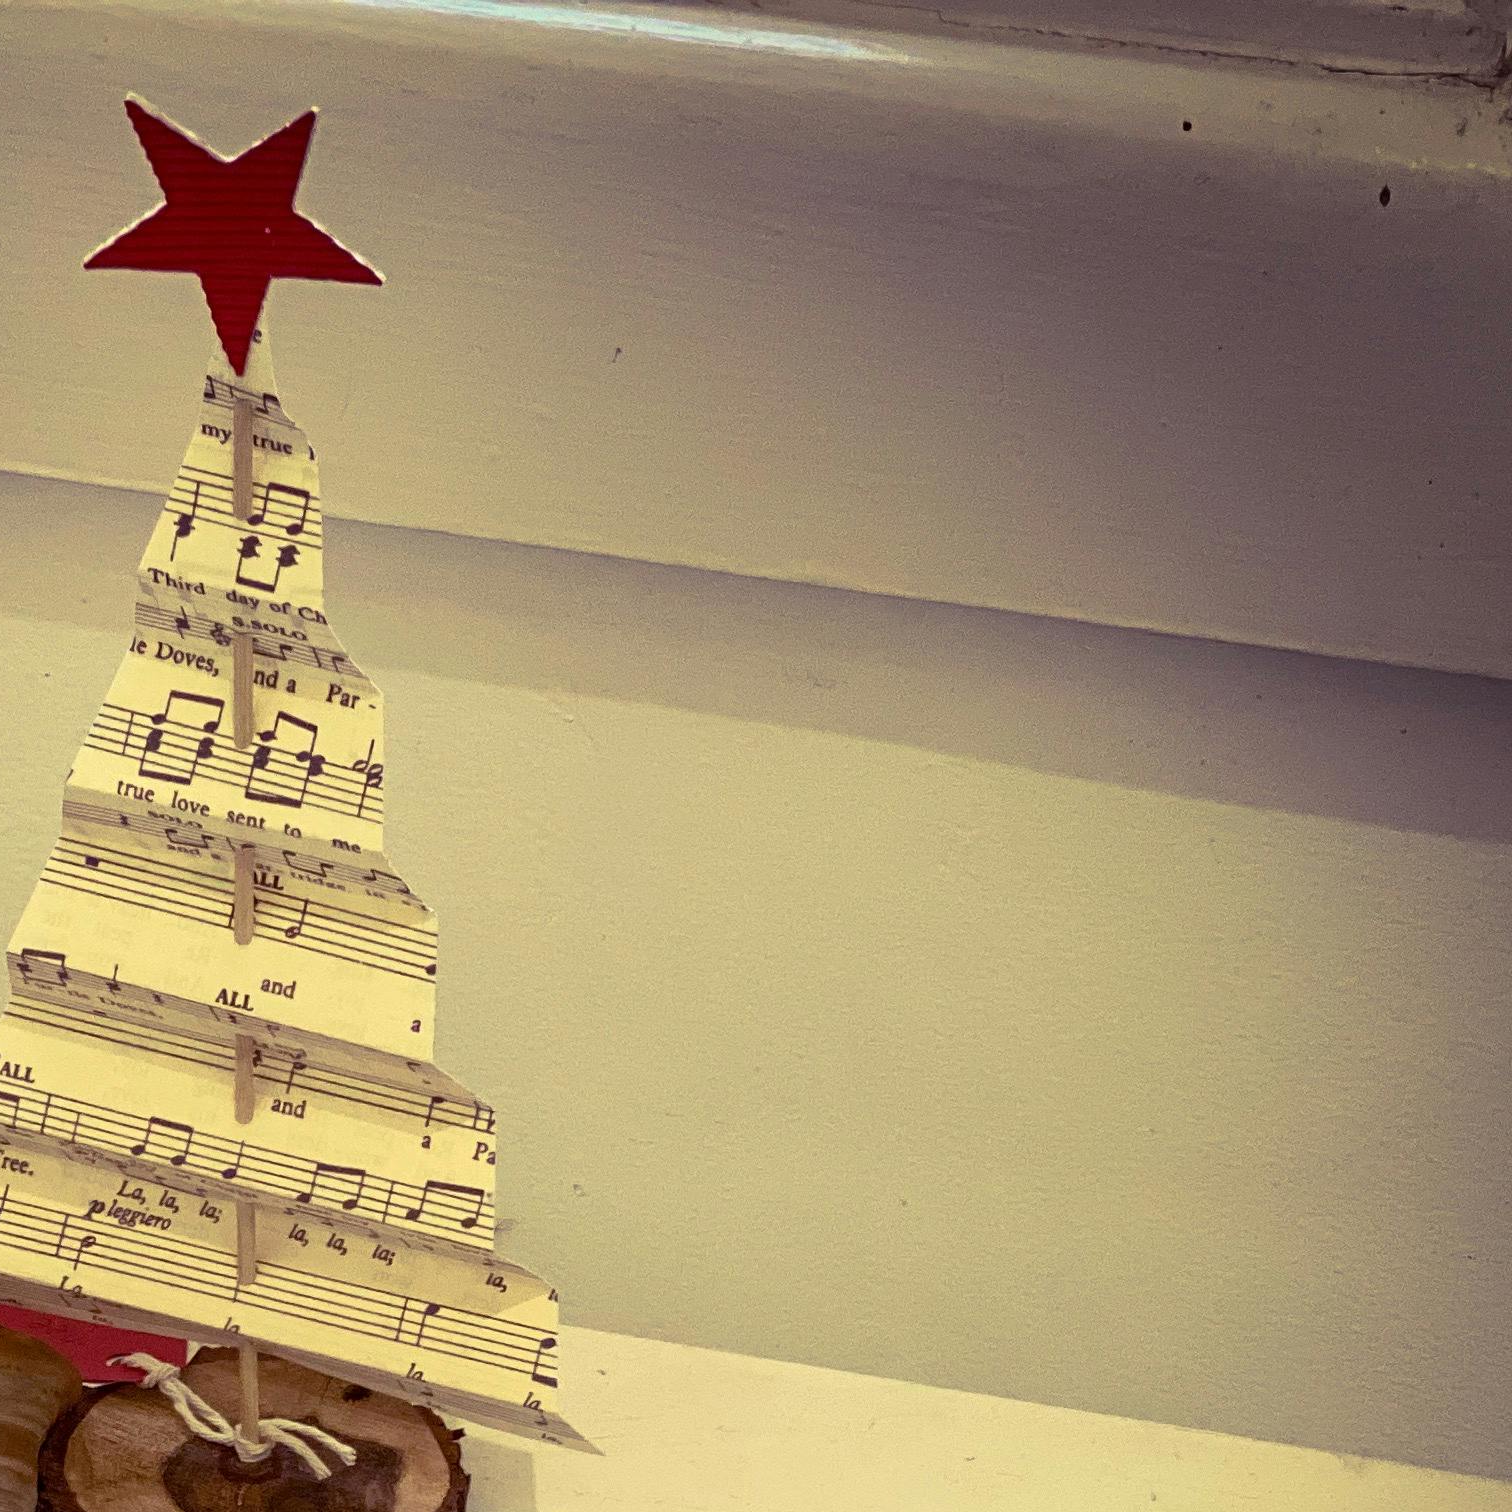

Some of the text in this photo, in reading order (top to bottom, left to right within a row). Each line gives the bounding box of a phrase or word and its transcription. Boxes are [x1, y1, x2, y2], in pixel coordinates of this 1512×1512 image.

[201, 423, 294, 455] my true
[146, 566, 206, 596] Third
[226, 590, 260, 610] day
[269, 602, 290, 615] of
[155, 641, 220, 677] Doves,
[287, 679, 297, 694] a
[116, 779, 363, 855] true love sent to me
[215, 987, 255, 1011] ALL
[260, 977, 298, 999] and
[410, 1017, 423, 1033] a
[270, 1099, 306, 1119] and
[421, 1135, 432, 1149] a
[107, 1202, 173, 1231] leggiero
